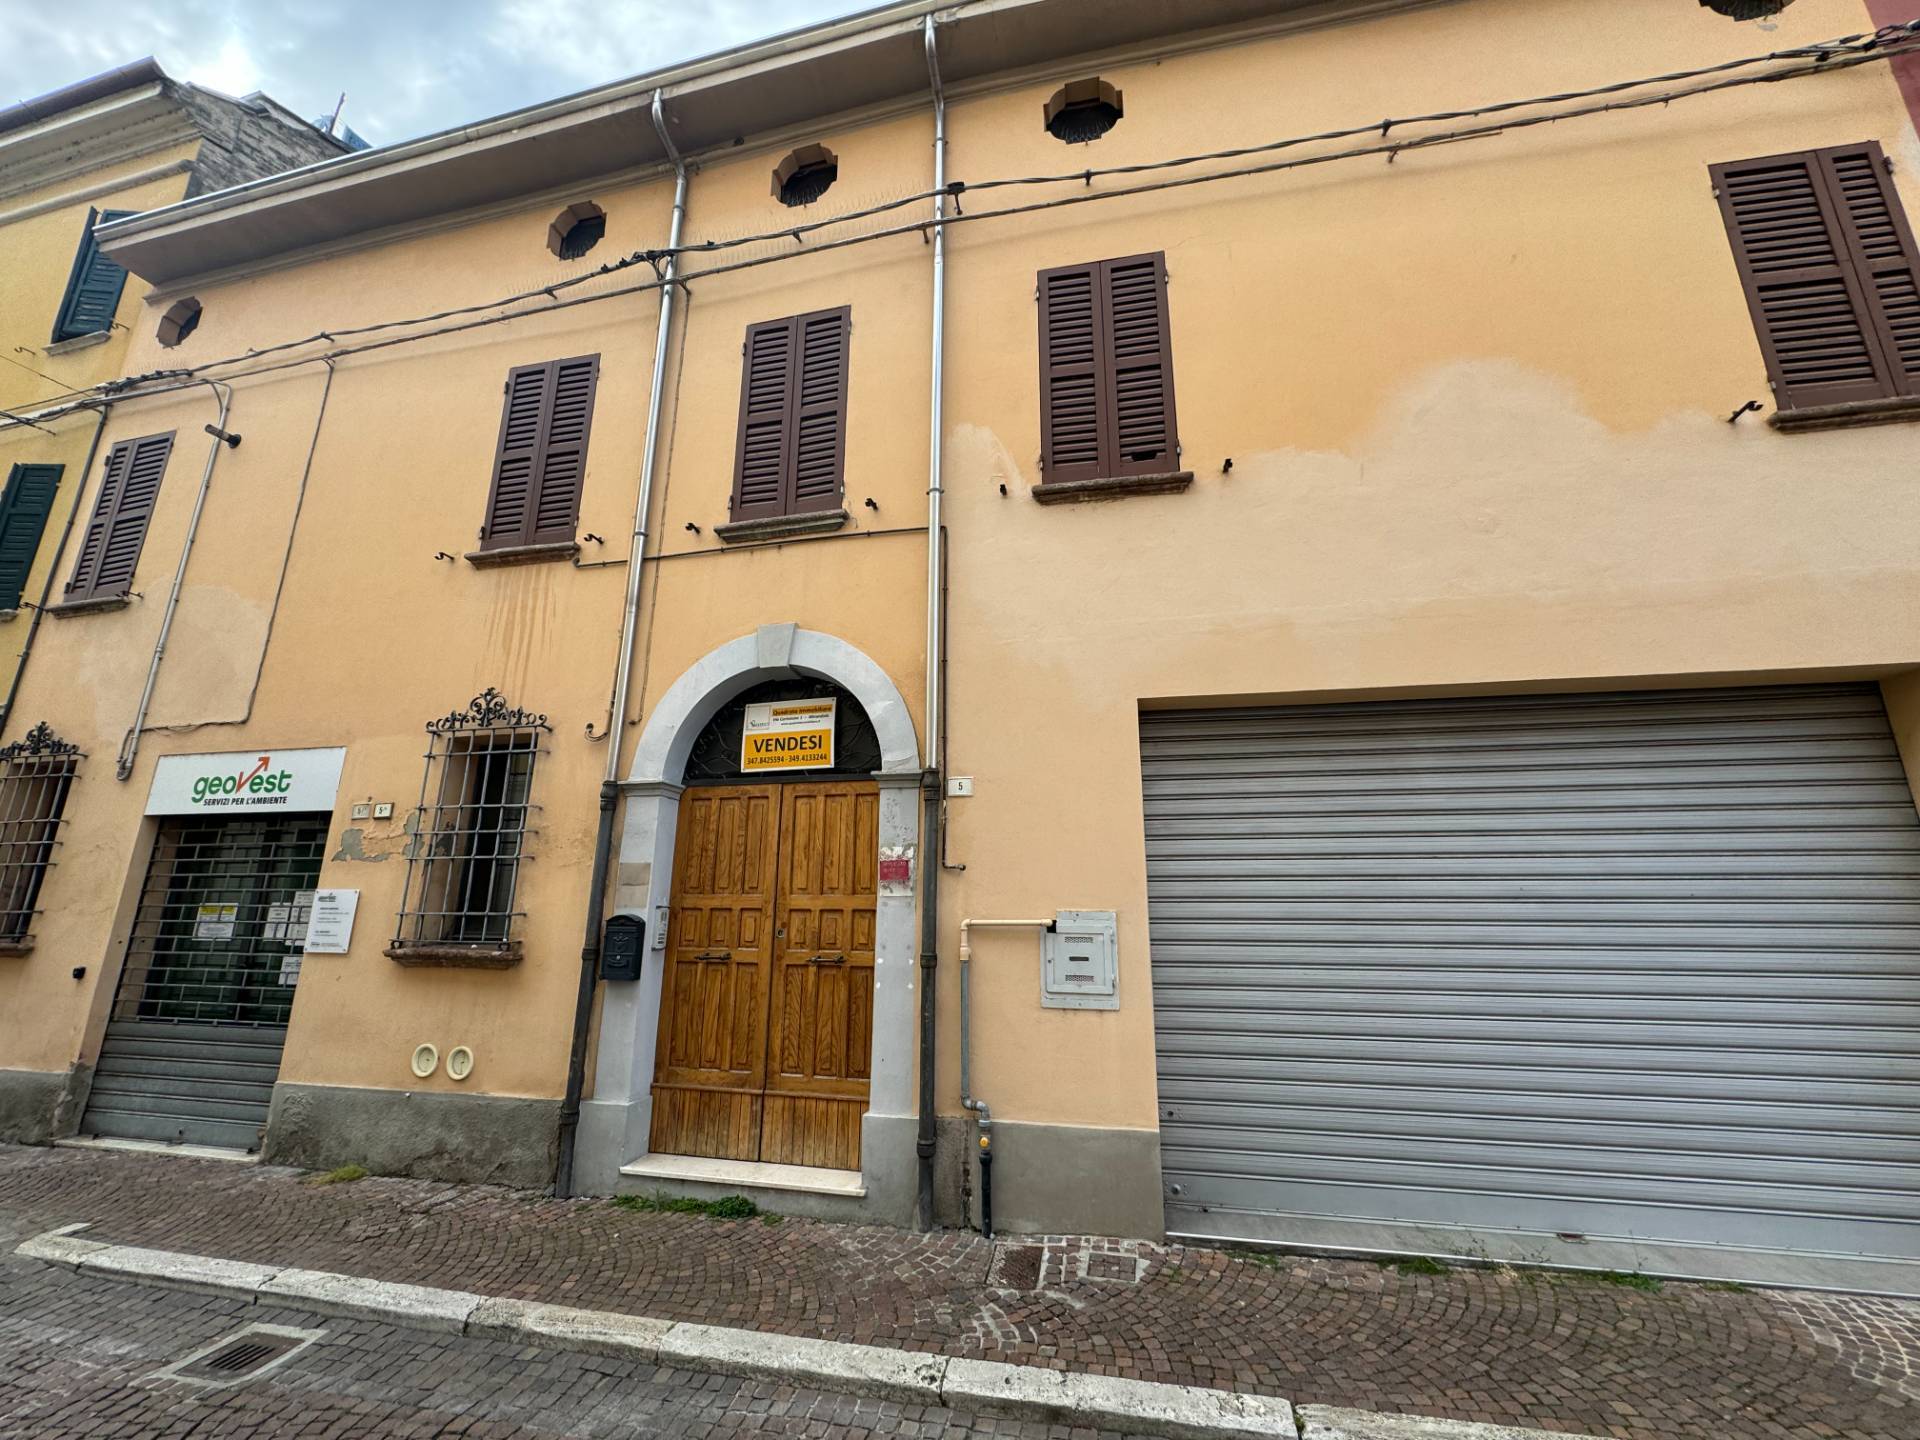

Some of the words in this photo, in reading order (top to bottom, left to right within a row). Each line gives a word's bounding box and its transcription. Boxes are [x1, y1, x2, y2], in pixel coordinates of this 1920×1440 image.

[753, 735, 822, 753] VENDESI
[958, 781, 963, 791] 5
[203, 798, 230, 806] SERVIZI
[246, 796, 287, 805] L'AMBIENTE
